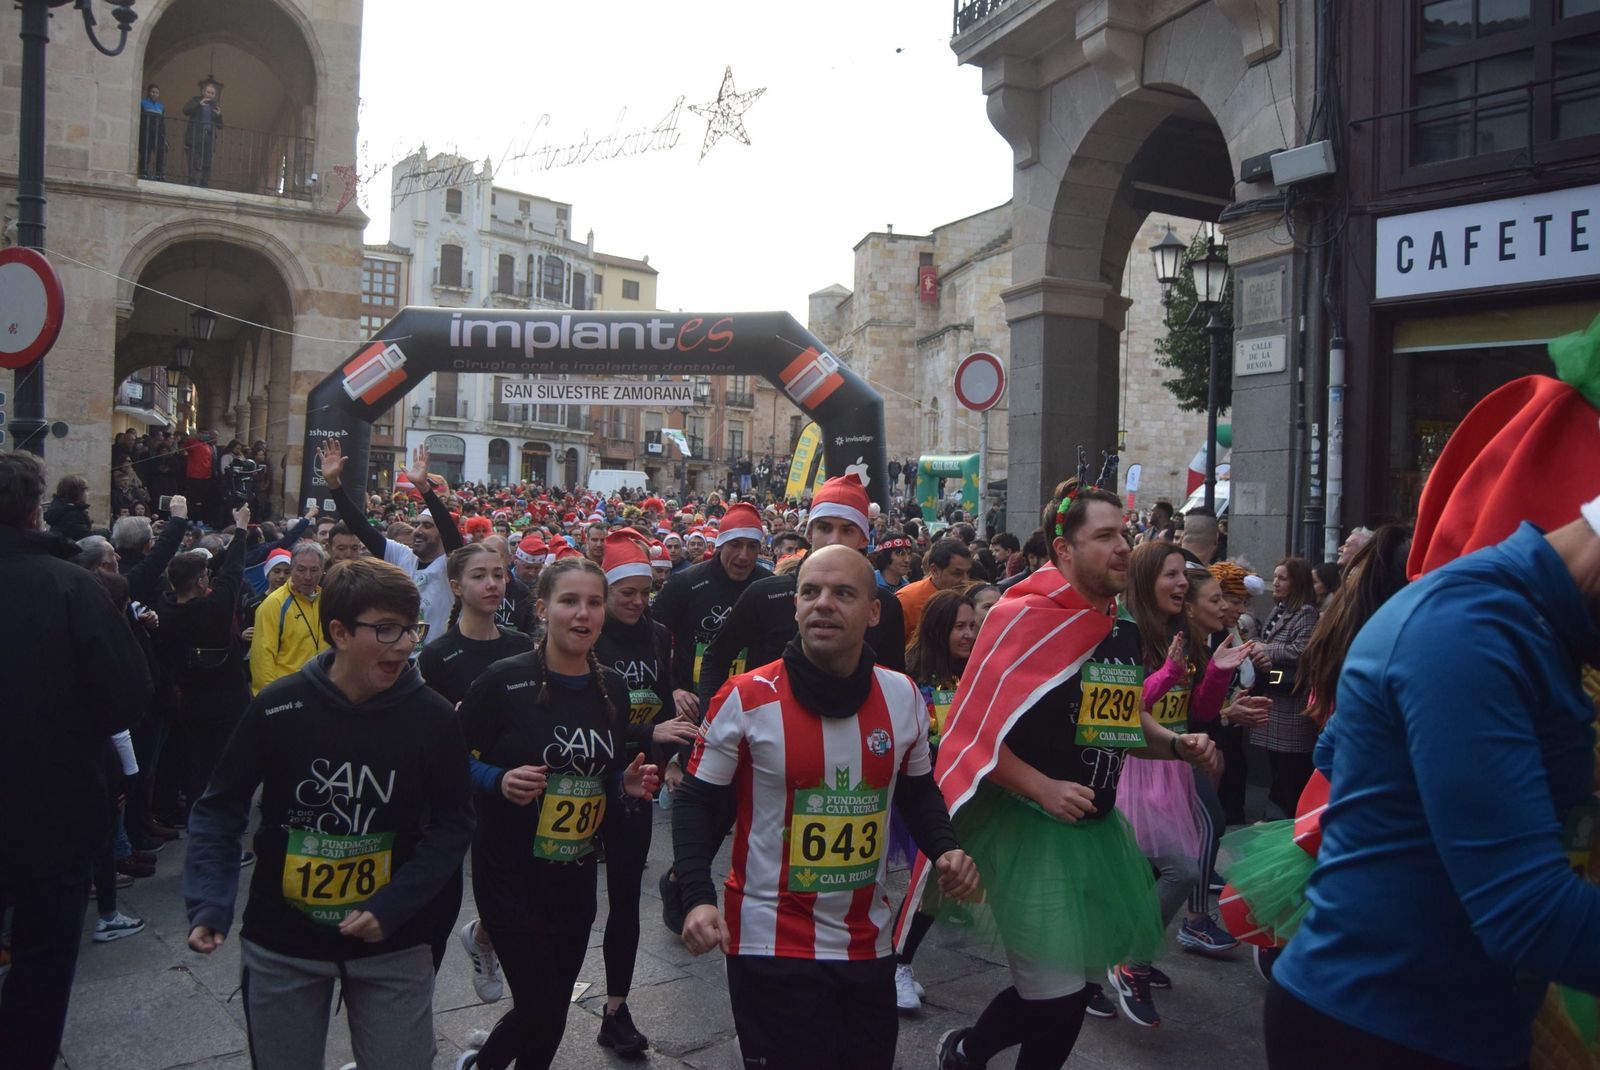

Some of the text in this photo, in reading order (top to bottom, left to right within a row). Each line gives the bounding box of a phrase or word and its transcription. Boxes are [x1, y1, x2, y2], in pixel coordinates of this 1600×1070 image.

[1396, 208, 1590, 274] CAFETE
[450, 313, 735, 358] implantes
[1251, 341, 1273, 352] CALLE
[1249, 351, 1270, 361] DE LA
[520, 361, 554, 371] oral
[1246, 362, 1273, 371] RENOVA
[504, 384, 692, 401] SAN SILVESTRE ZAMORANA
[265, 700, 294, 716] luanvi
[1089, 686, 1136, 722] 1239
[1100, 731, 1142, 742] CAJA RURAL
[543, 725, 614, 769] SAN
[296, 758, 396, 807] SAN
[826, 802, 879, 814] CAJA RURAL
[551, 799, 602, 834] 281
[802, 820, 878, 862] 643
[320, 848, 345, 858] CAJA
[296, 858, 376, 899] 1278
[820, 869, 875, 884] CAJA RURAL
[312, 910, 341, 920] CAJA
